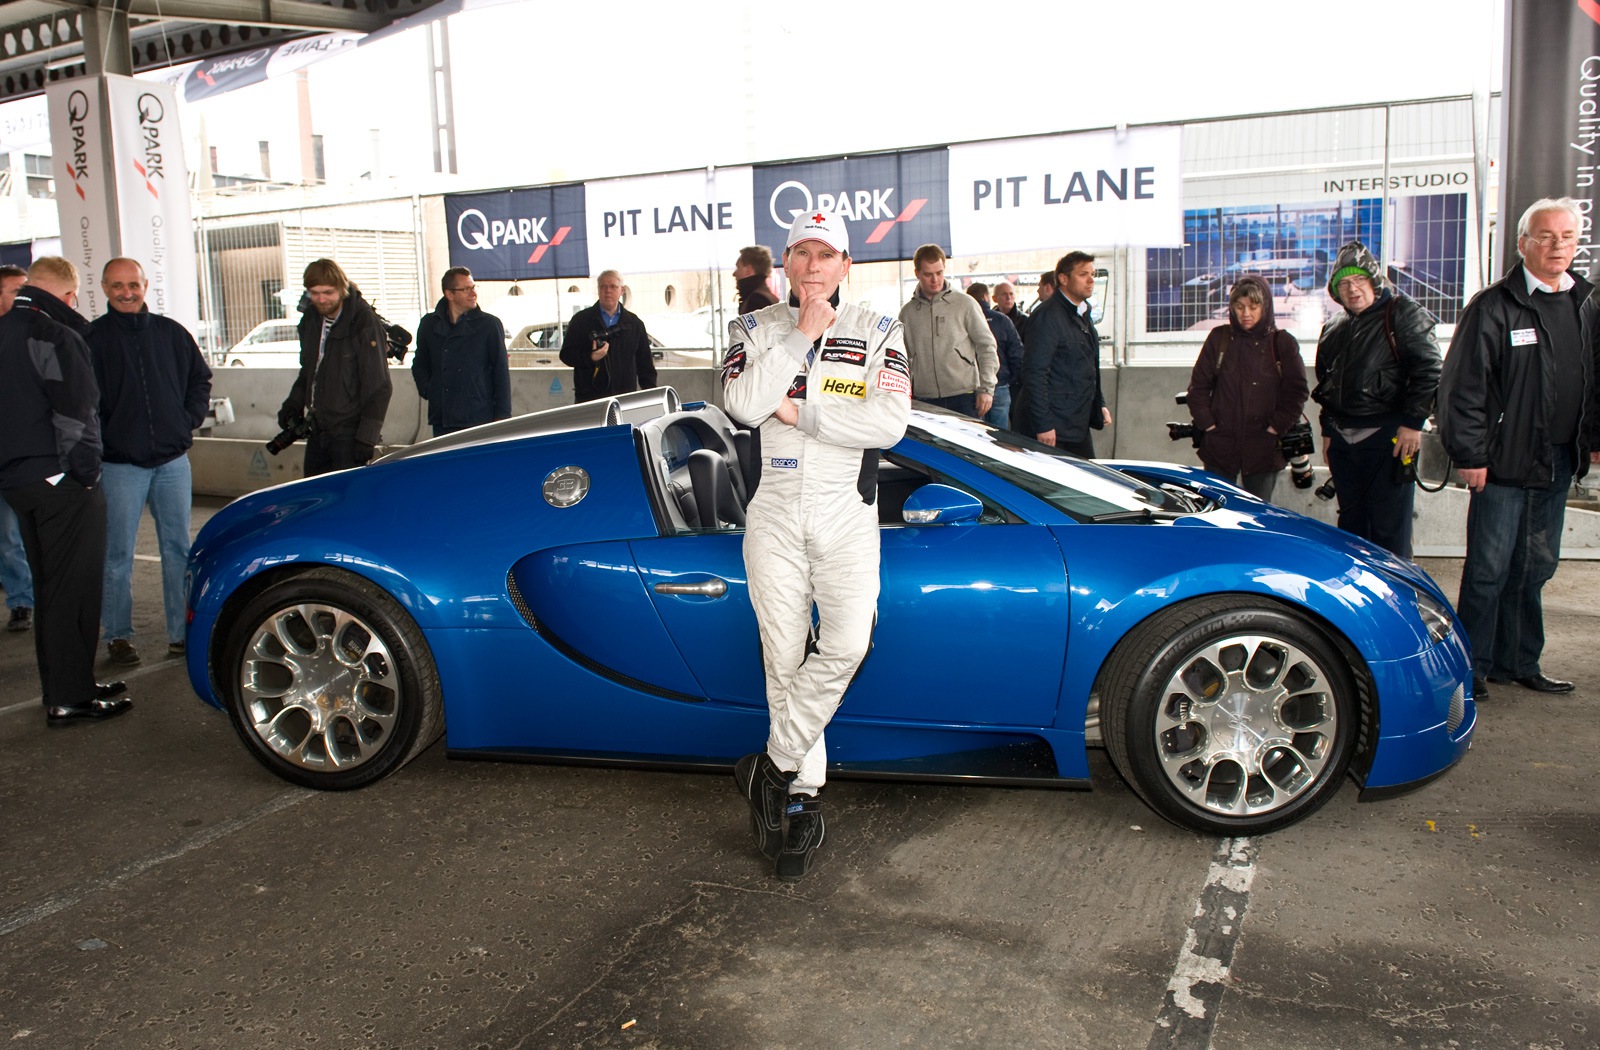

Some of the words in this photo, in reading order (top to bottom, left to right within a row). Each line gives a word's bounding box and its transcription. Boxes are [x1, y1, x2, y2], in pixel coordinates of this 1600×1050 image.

[1570, 55, 1600, 156] Quality
[973, 176, 1027, 211] PIT
[1044, 166, 1155, 205] LANE
[1323, 171, 1469, 194] INTERSTUDIO
[1576, 165, 1600, 188] in
[604, 209, 642, 237] PIT
[654, 201, 733, 234] LANE
[80, 216, 93, 268] Quality
[151, 215, 165, 266] Quality
[1572, 199, 1600, 280] parkin
[86, 273, 94, 285] in
[155, 271, 165, 283] in
[86, 290, 99, 320] park
[824, 351, 861, 362] ADVAN
[836, 339, 865, 348] YOKOHAMA
[823, 378, 865, 397] Hertz
[348, 640, 365, 657] BUGAT
[1164, 620, 1223, 661] MICHELIN
